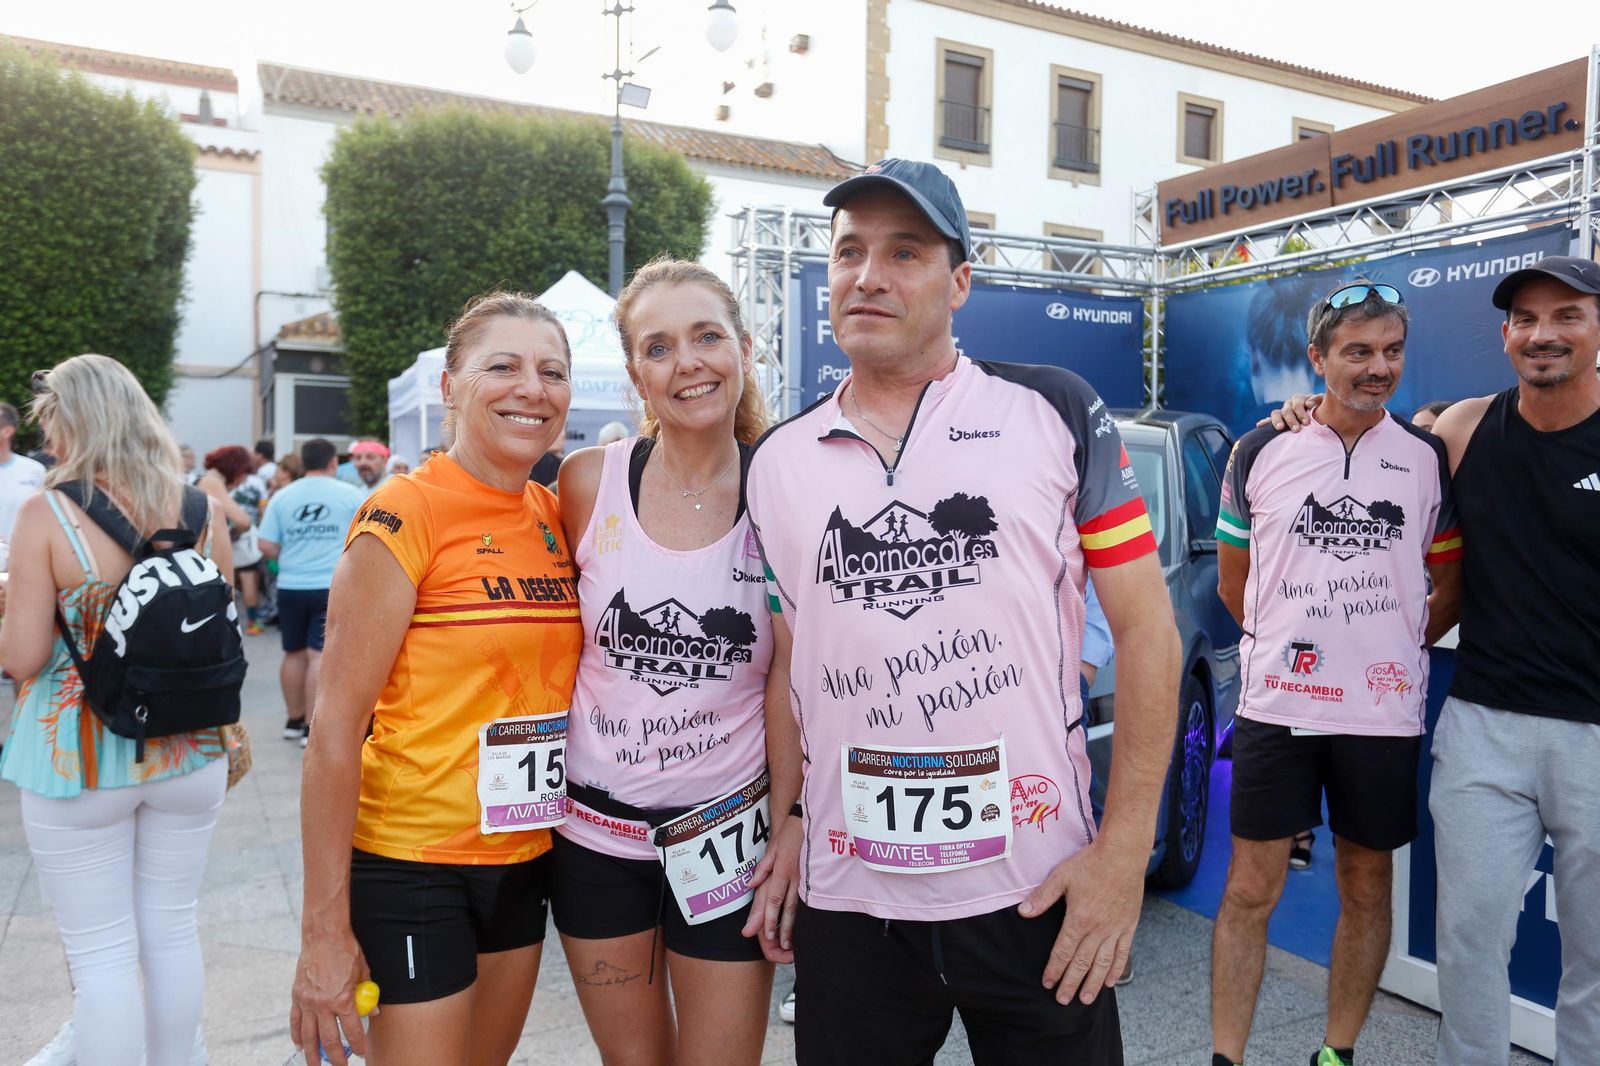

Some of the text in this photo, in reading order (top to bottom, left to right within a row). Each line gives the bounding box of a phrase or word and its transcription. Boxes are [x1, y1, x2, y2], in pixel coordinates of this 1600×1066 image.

[1164, 101, 1579, 228] Full Power. Full Runner.
[1073, 306, 1133, 325] HYUNDAI
[1303, 536, 1388, 549] TRAIL
[481, 576, 516, 601] LA
[835, 568, 975, 599] TRAIL
[1278, 579, 1317, 601] Una
[105, 557, 183, 658] JUST
[863, 595, 945, 611] RUNNING
[1306, 593, 1400, 625] mi pasión
[609, 653, 728, 679] TRAIL
[1290, 642, 1318, 675] TR
[630, 674, 700, 689] RUNNING
[821, 664, 873, 700] Una
[1264, 680, 1344, 697] TU RECAMBIO
[866, 664, 1023, 733] mi pasión
[1310, 694, 1343, 703] ALGECIRAS
[498, 722, 537, 737] CARRERA
[590, 705, 632, 738] Una
[616, 742, 646, 765] mi
[857, 753, 892, 766] CARRERA
[892, 754, 945, 768] NOCTURNA
[945, 750, 998, 768] SOLIDARIA
[518, 747, 566, 793] 15
[883, 768, 903, 776] corre
[904, 769, 917, 779] por
[926, 768, 956, 780] igualdad
[506, 801, 562, 820] AVATEL
[668, 815, 705, 837] CARRERA
[702, 794, 744, 821] NOCTURNA
[876, 785, 973, 833] 175
[576, 808, 647, 836] RECAMBIO
[610, 830, 647, 842] ALGECIRAS
[699, 807, 769, 875] 174
[828, 829, 847, 839] GRUPO
[829, 838, 845, 856] TU
[869, 842, 934, 860] AVATEL
[734, 856, 758, 876] RUBY
